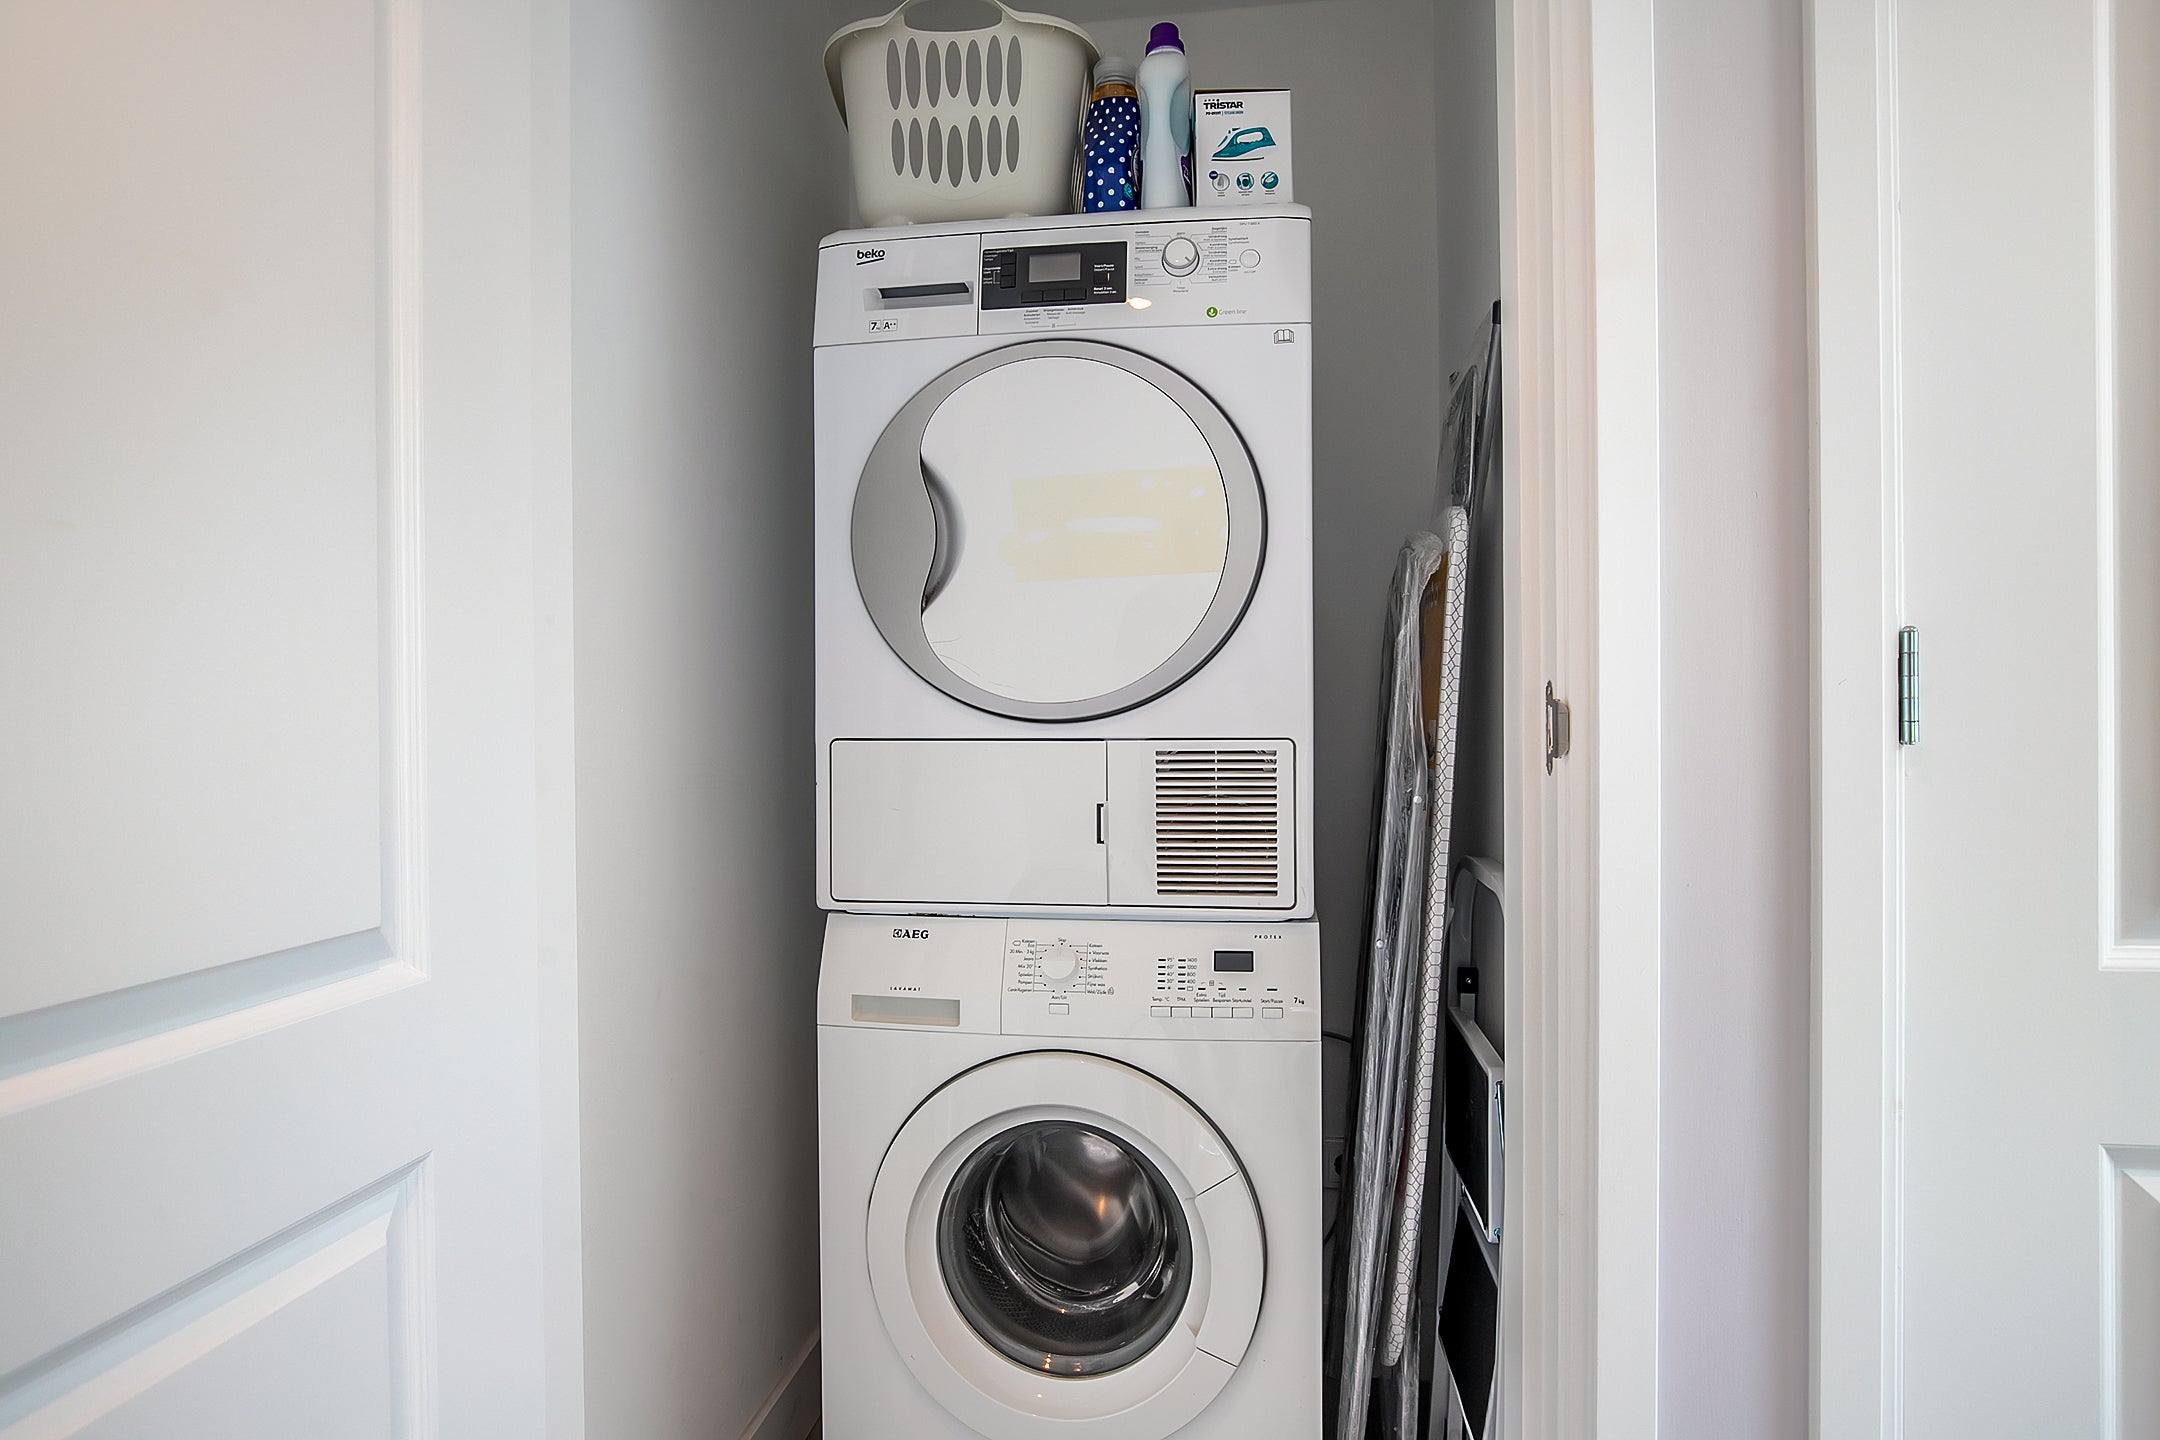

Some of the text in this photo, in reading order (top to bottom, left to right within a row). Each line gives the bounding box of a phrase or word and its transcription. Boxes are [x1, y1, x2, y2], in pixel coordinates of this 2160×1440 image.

[856, 248, 885, 260] beko
[870, 322, 877, 330] 7
[902, 929, 929, 939] AEG
